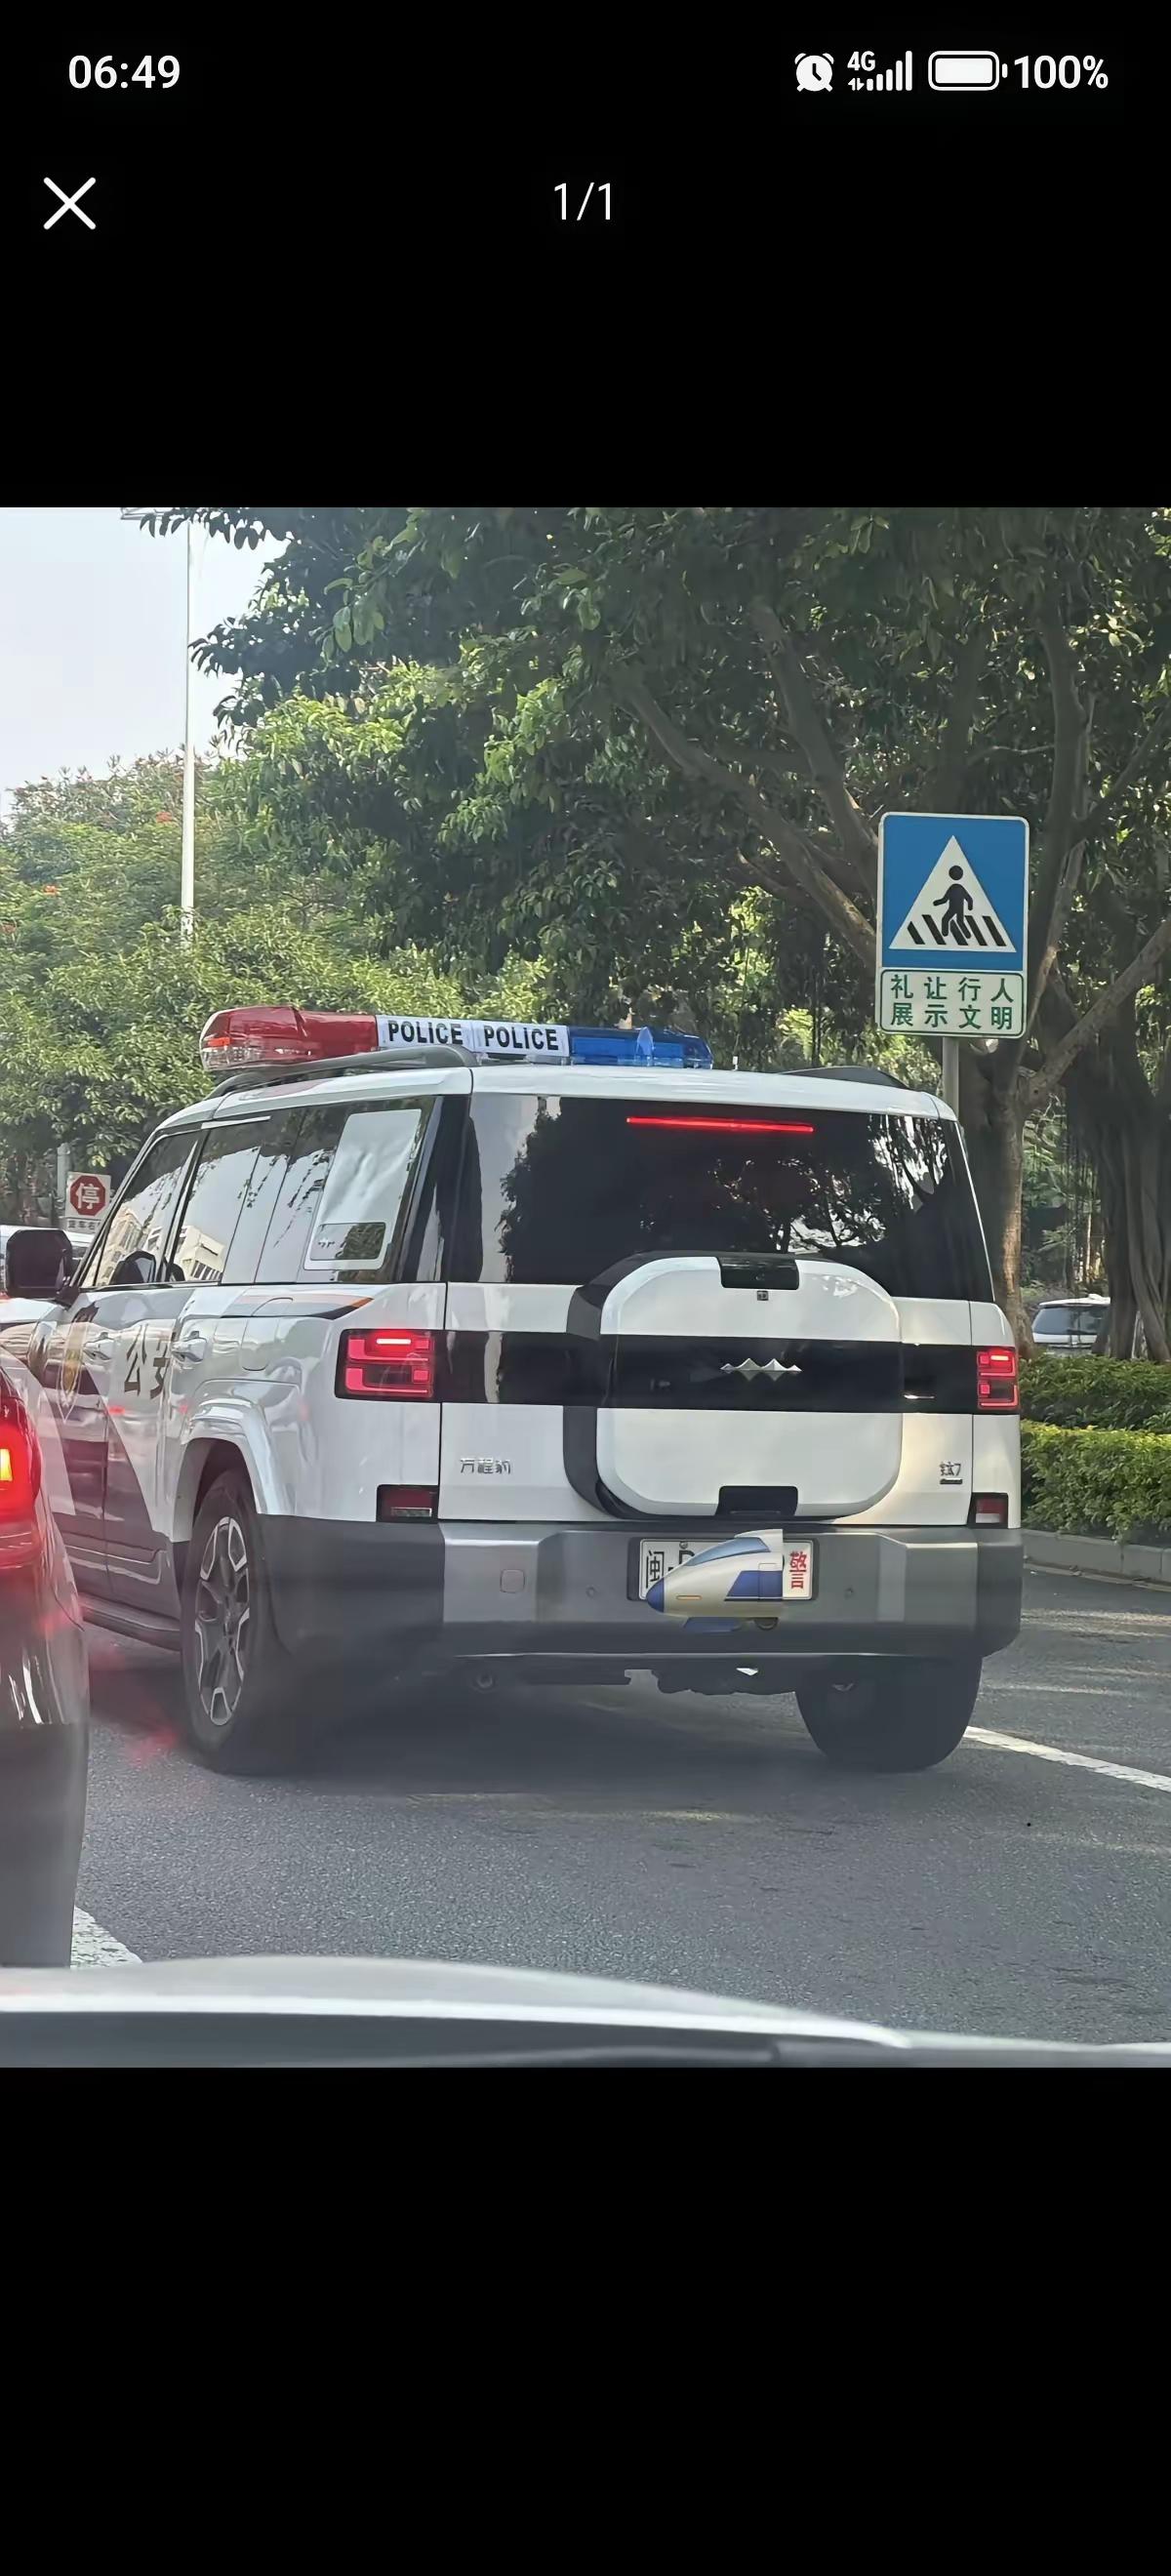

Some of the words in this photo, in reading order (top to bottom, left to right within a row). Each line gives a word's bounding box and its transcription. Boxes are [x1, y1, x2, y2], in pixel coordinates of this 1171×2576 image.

[890, 974, 1014, 1003] 礼让行人
[890, 1002, 1014, 1030] 展示文明
[387, 1020, 464, 1045] POLICE
[483, 1025, 559, 1051] POLICE
[75, 1183, 101, 1210] 停
[789, 1550, 808, 1590] 警
